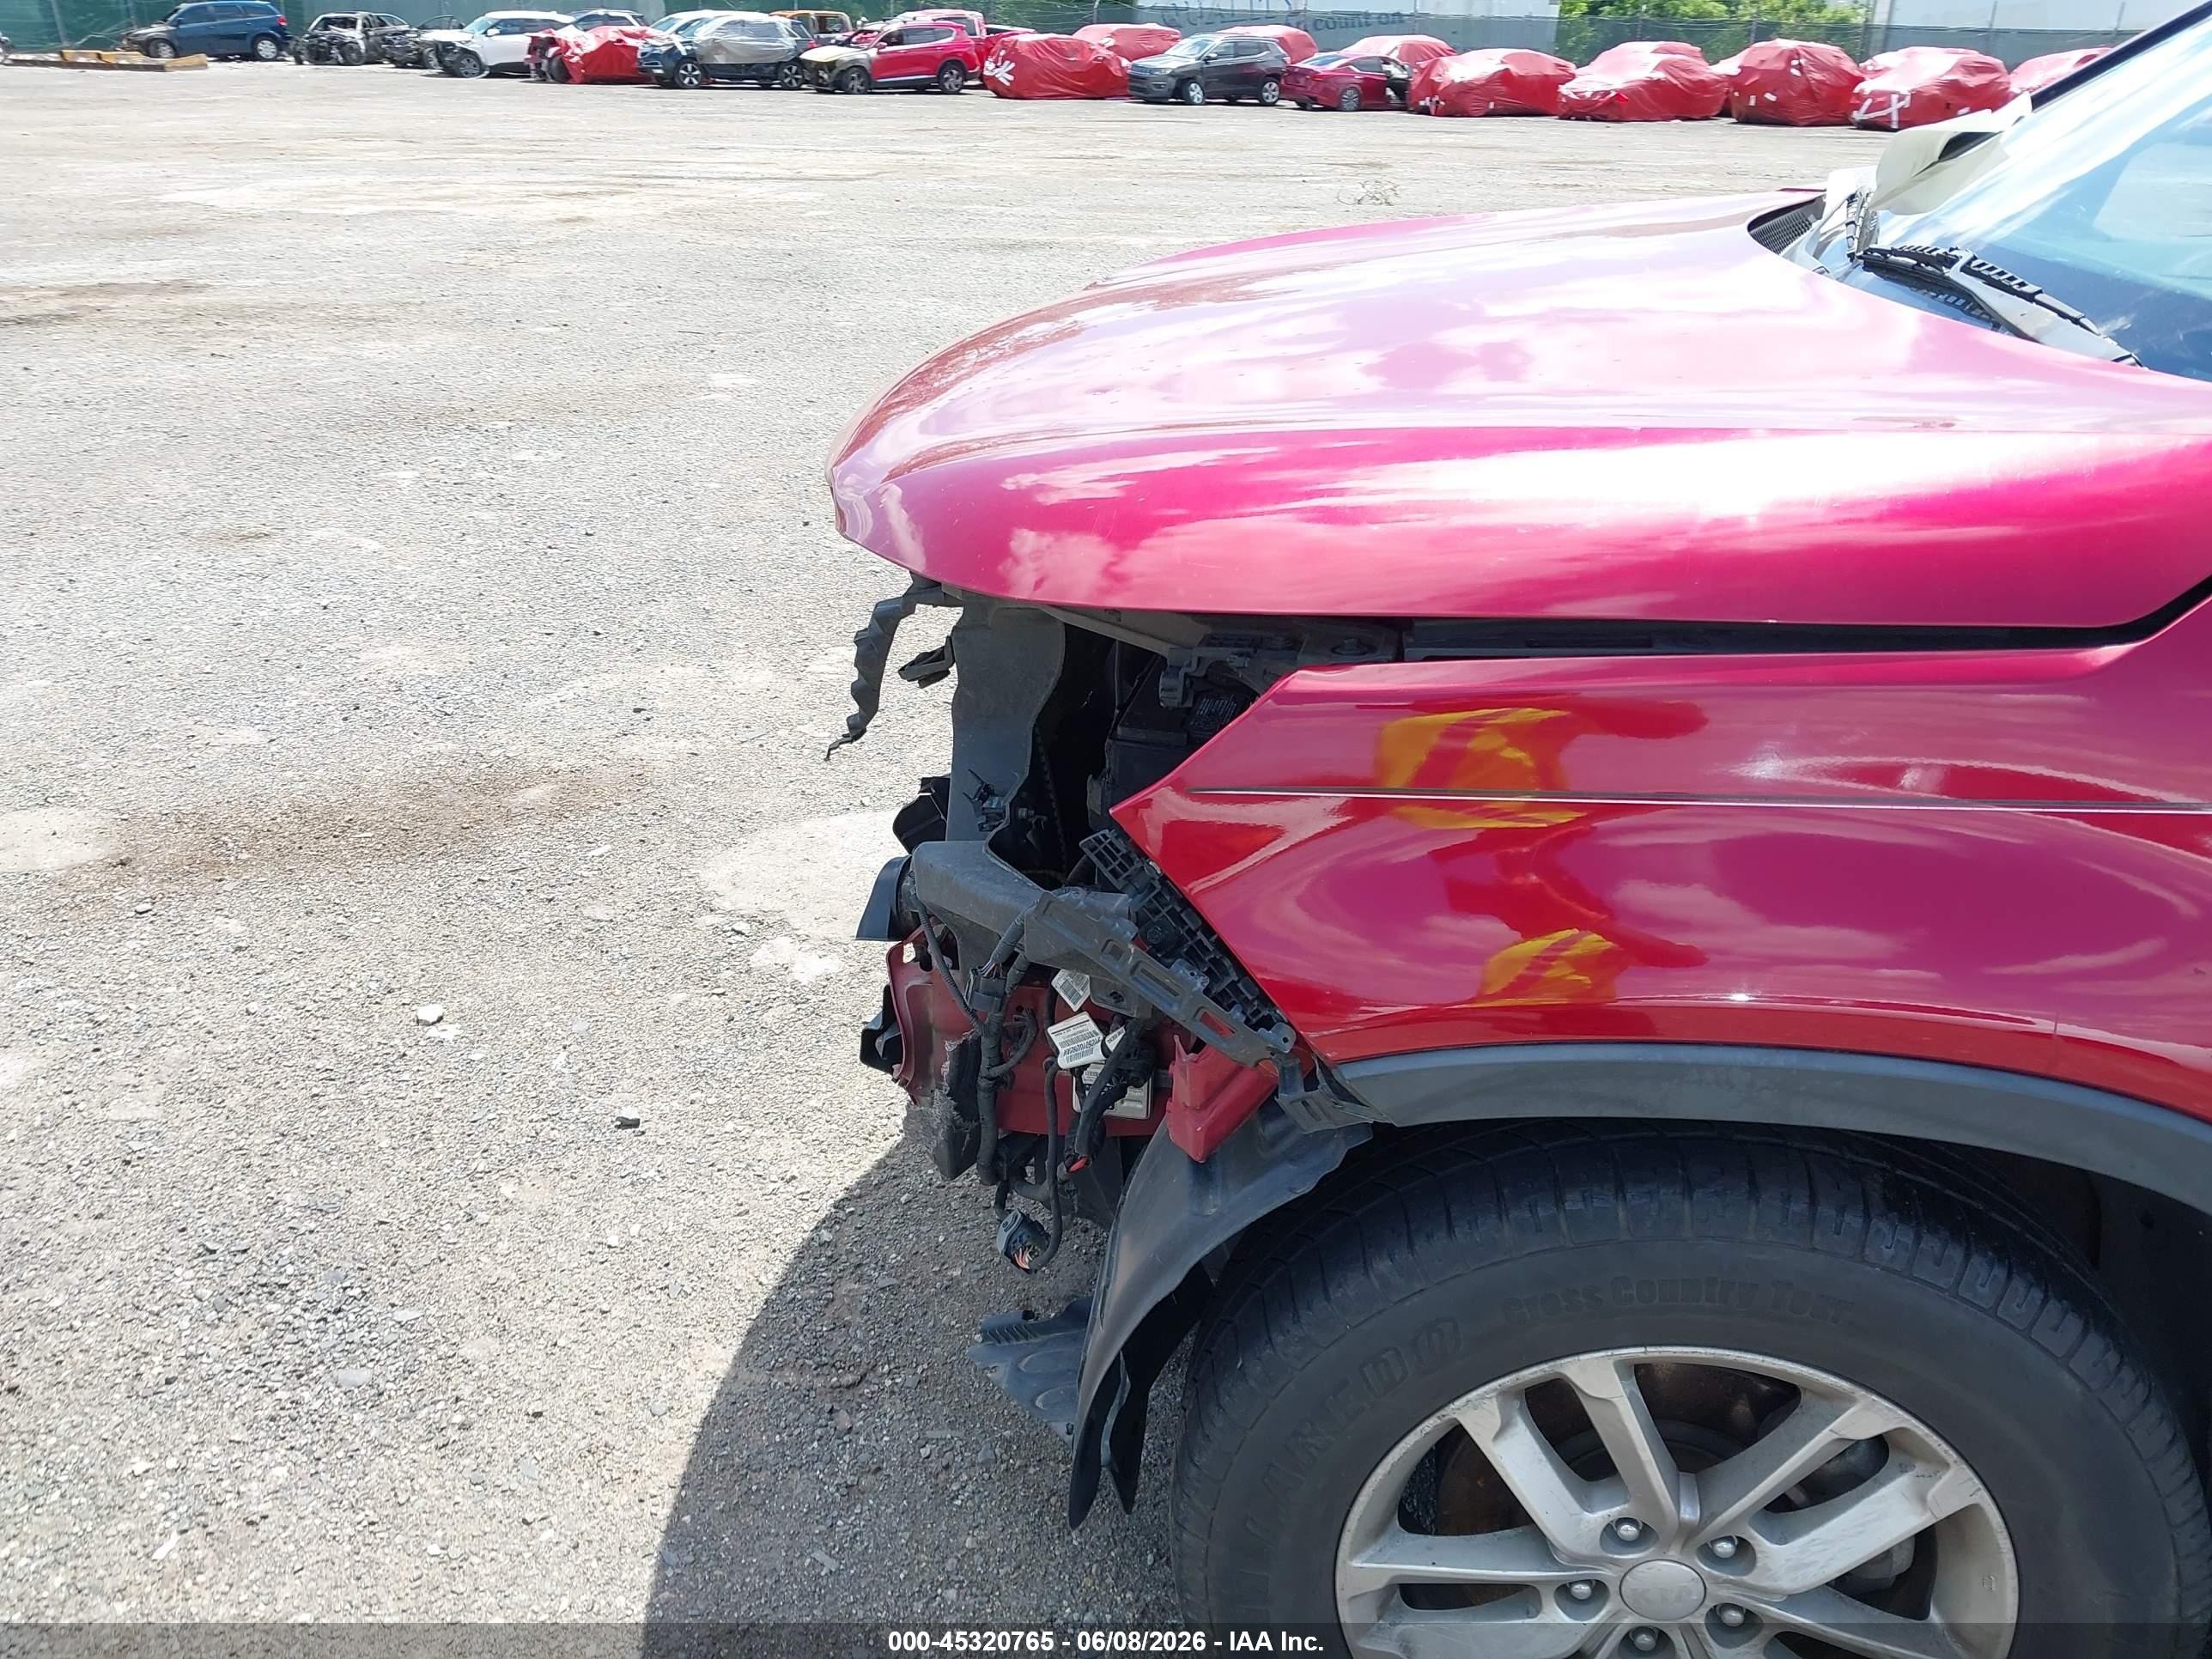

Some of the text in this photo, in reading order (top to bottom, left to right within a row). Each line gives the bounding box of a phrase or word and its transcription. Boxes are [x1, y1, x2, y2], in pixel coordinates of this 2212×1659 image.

[1314, 13, 1372, 31] count
[1500, 1275, 1856, 1325] Cross Country Tour
